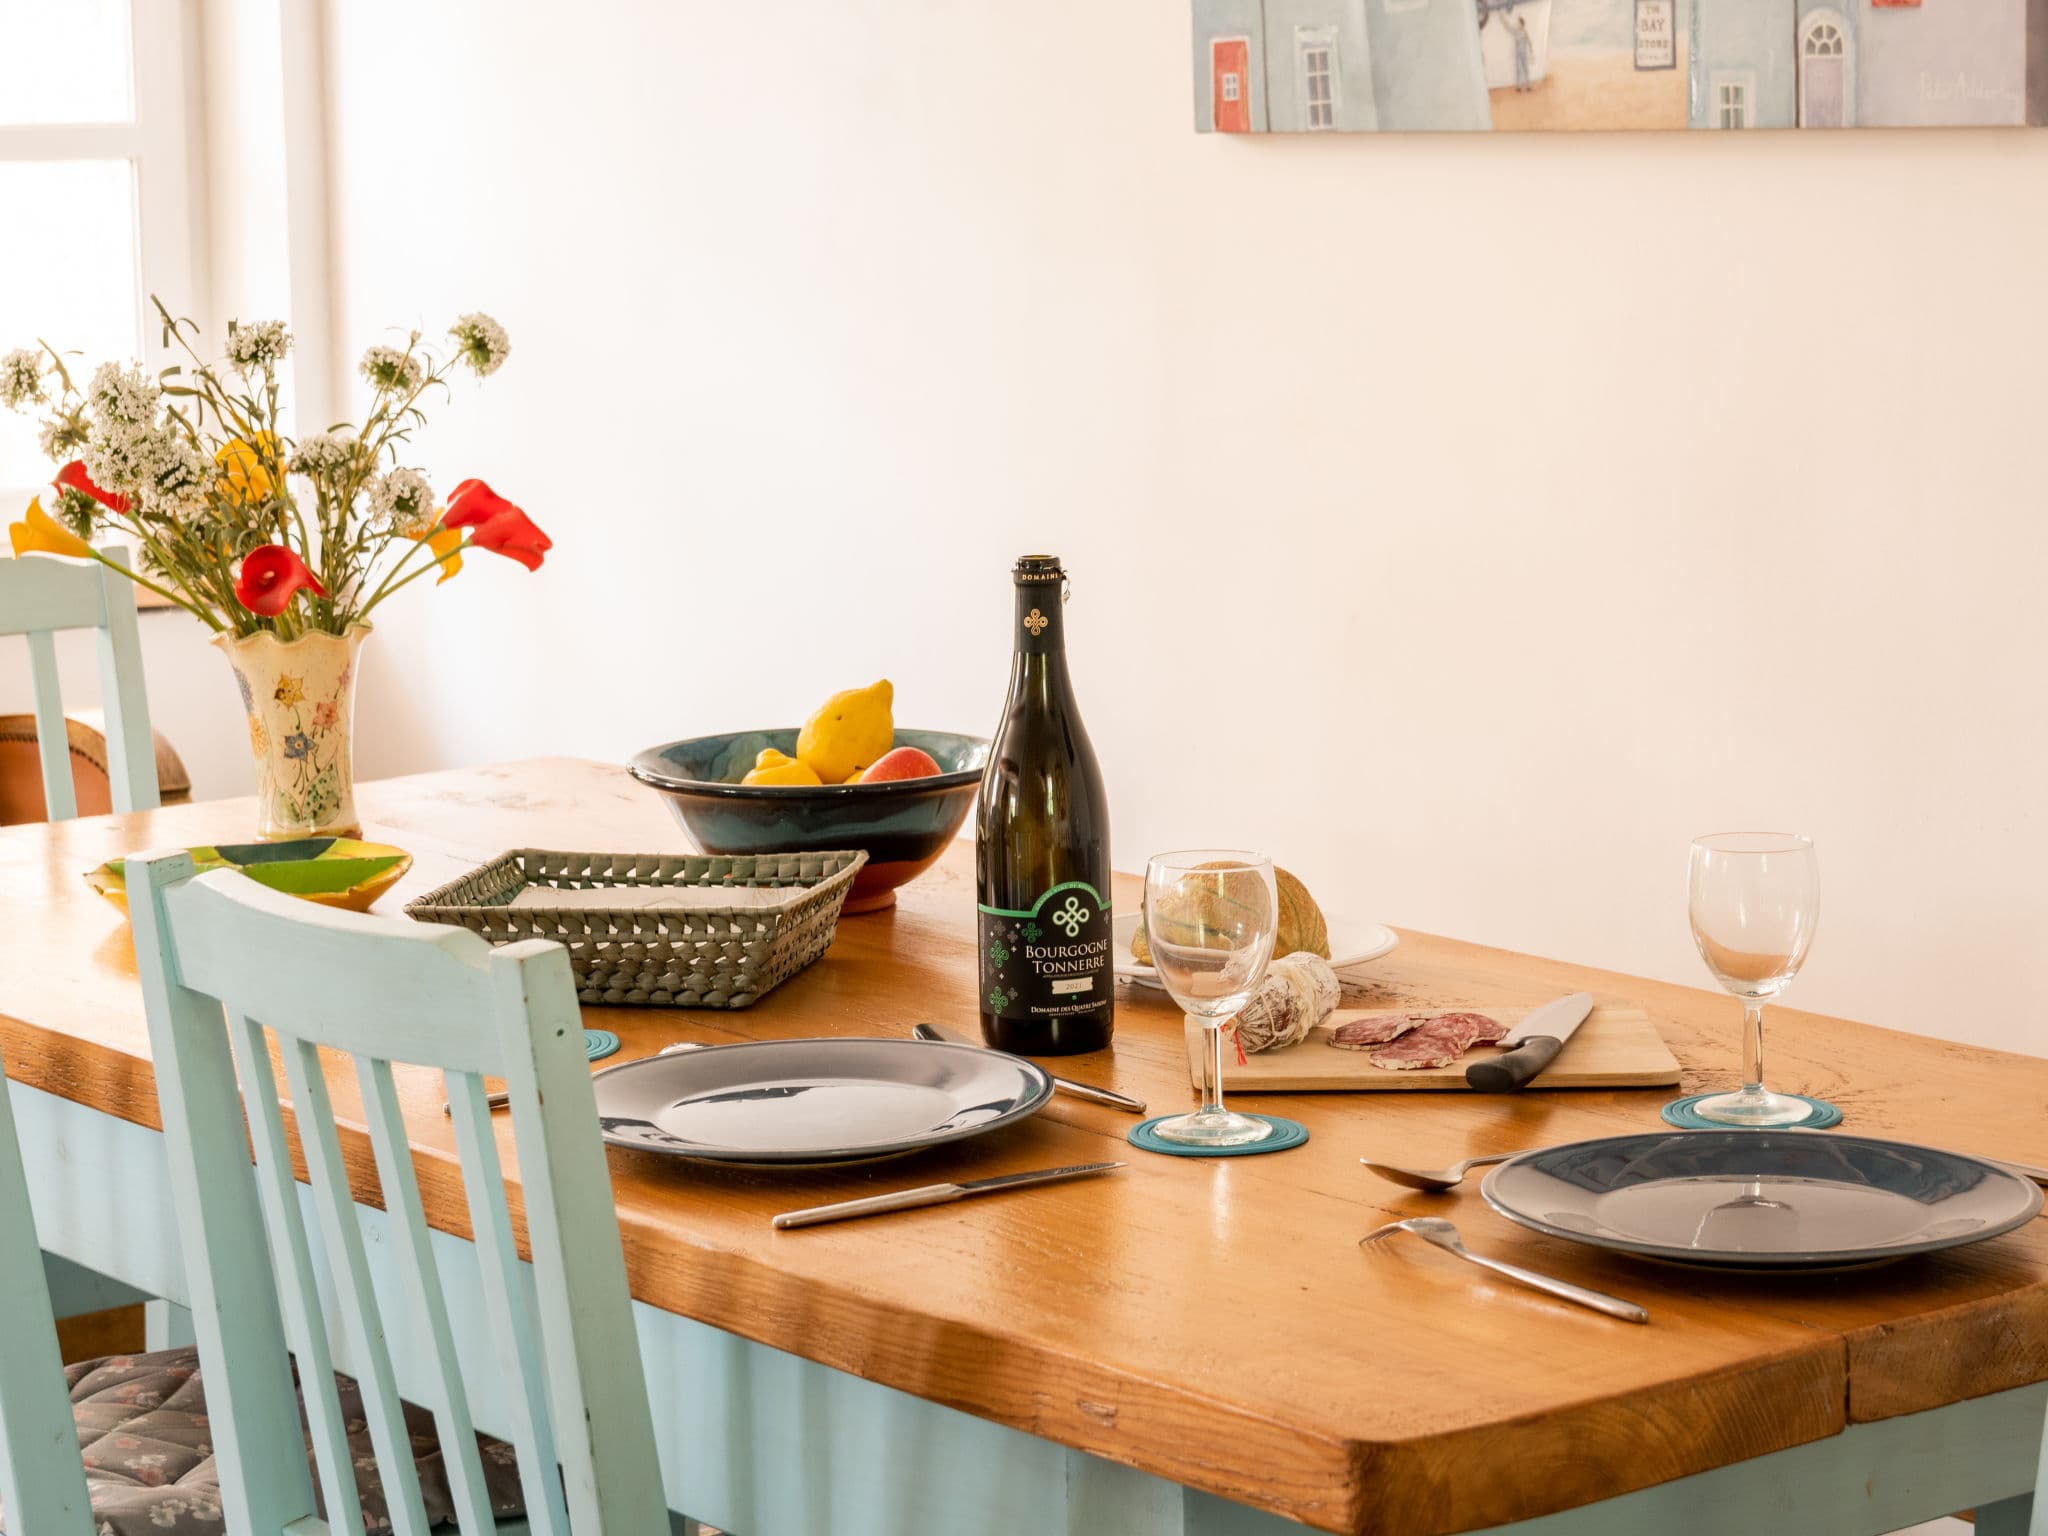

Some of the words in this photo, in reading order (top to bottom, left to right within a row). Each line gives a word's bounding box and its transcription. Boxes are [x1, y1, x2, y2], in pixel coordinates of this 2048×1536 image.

[1640, 18, 1665, 32] BAY
[1026, 939, 1107, 959] BOURGOGNE
[1032, 955, 1105, 974] TONNERRE
[1031, 1006, 1060, 1014] DOMAINE
